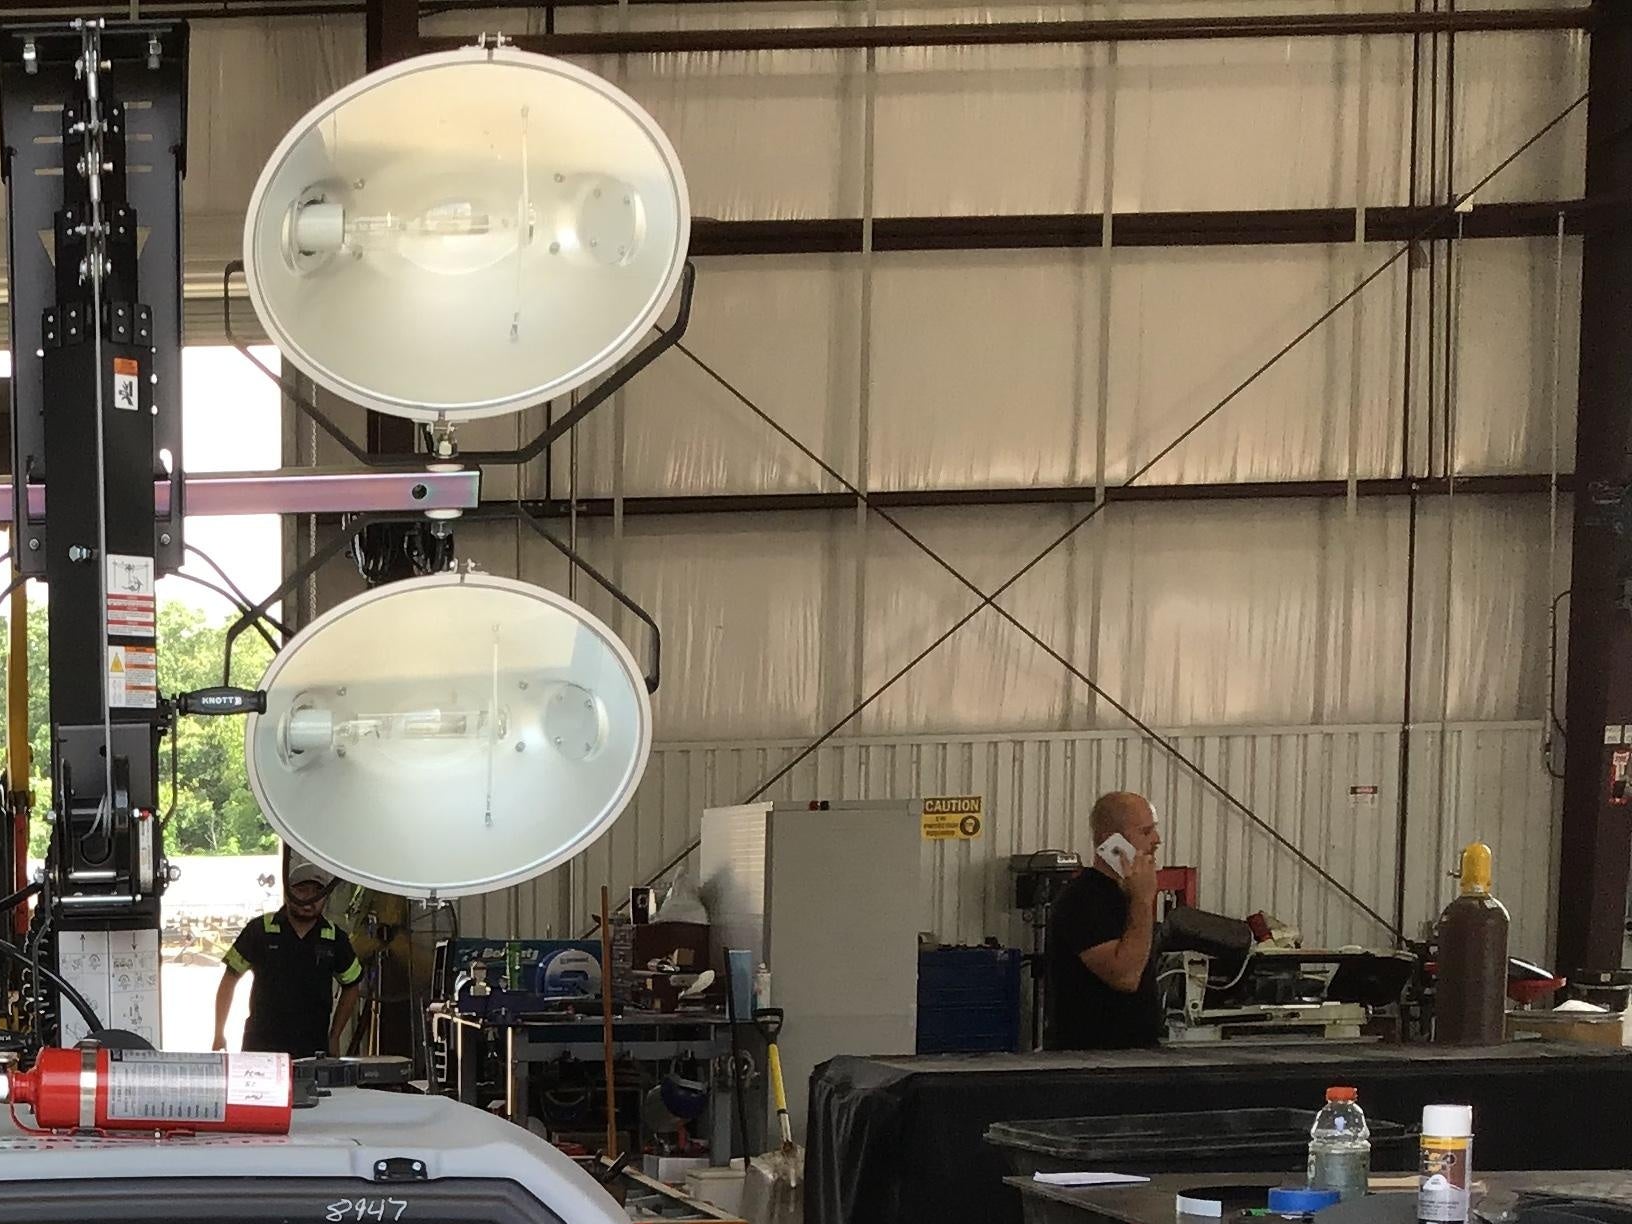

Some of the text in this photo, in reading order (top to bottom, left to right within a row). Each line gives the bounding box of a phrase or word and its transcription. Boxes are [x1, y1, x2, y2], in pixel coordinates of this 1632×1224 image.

[202, 696, 235, 705] KNOTT
[925, 799, 979, 812] CAUTION
[325, 1197, 408, 1222] 8947
